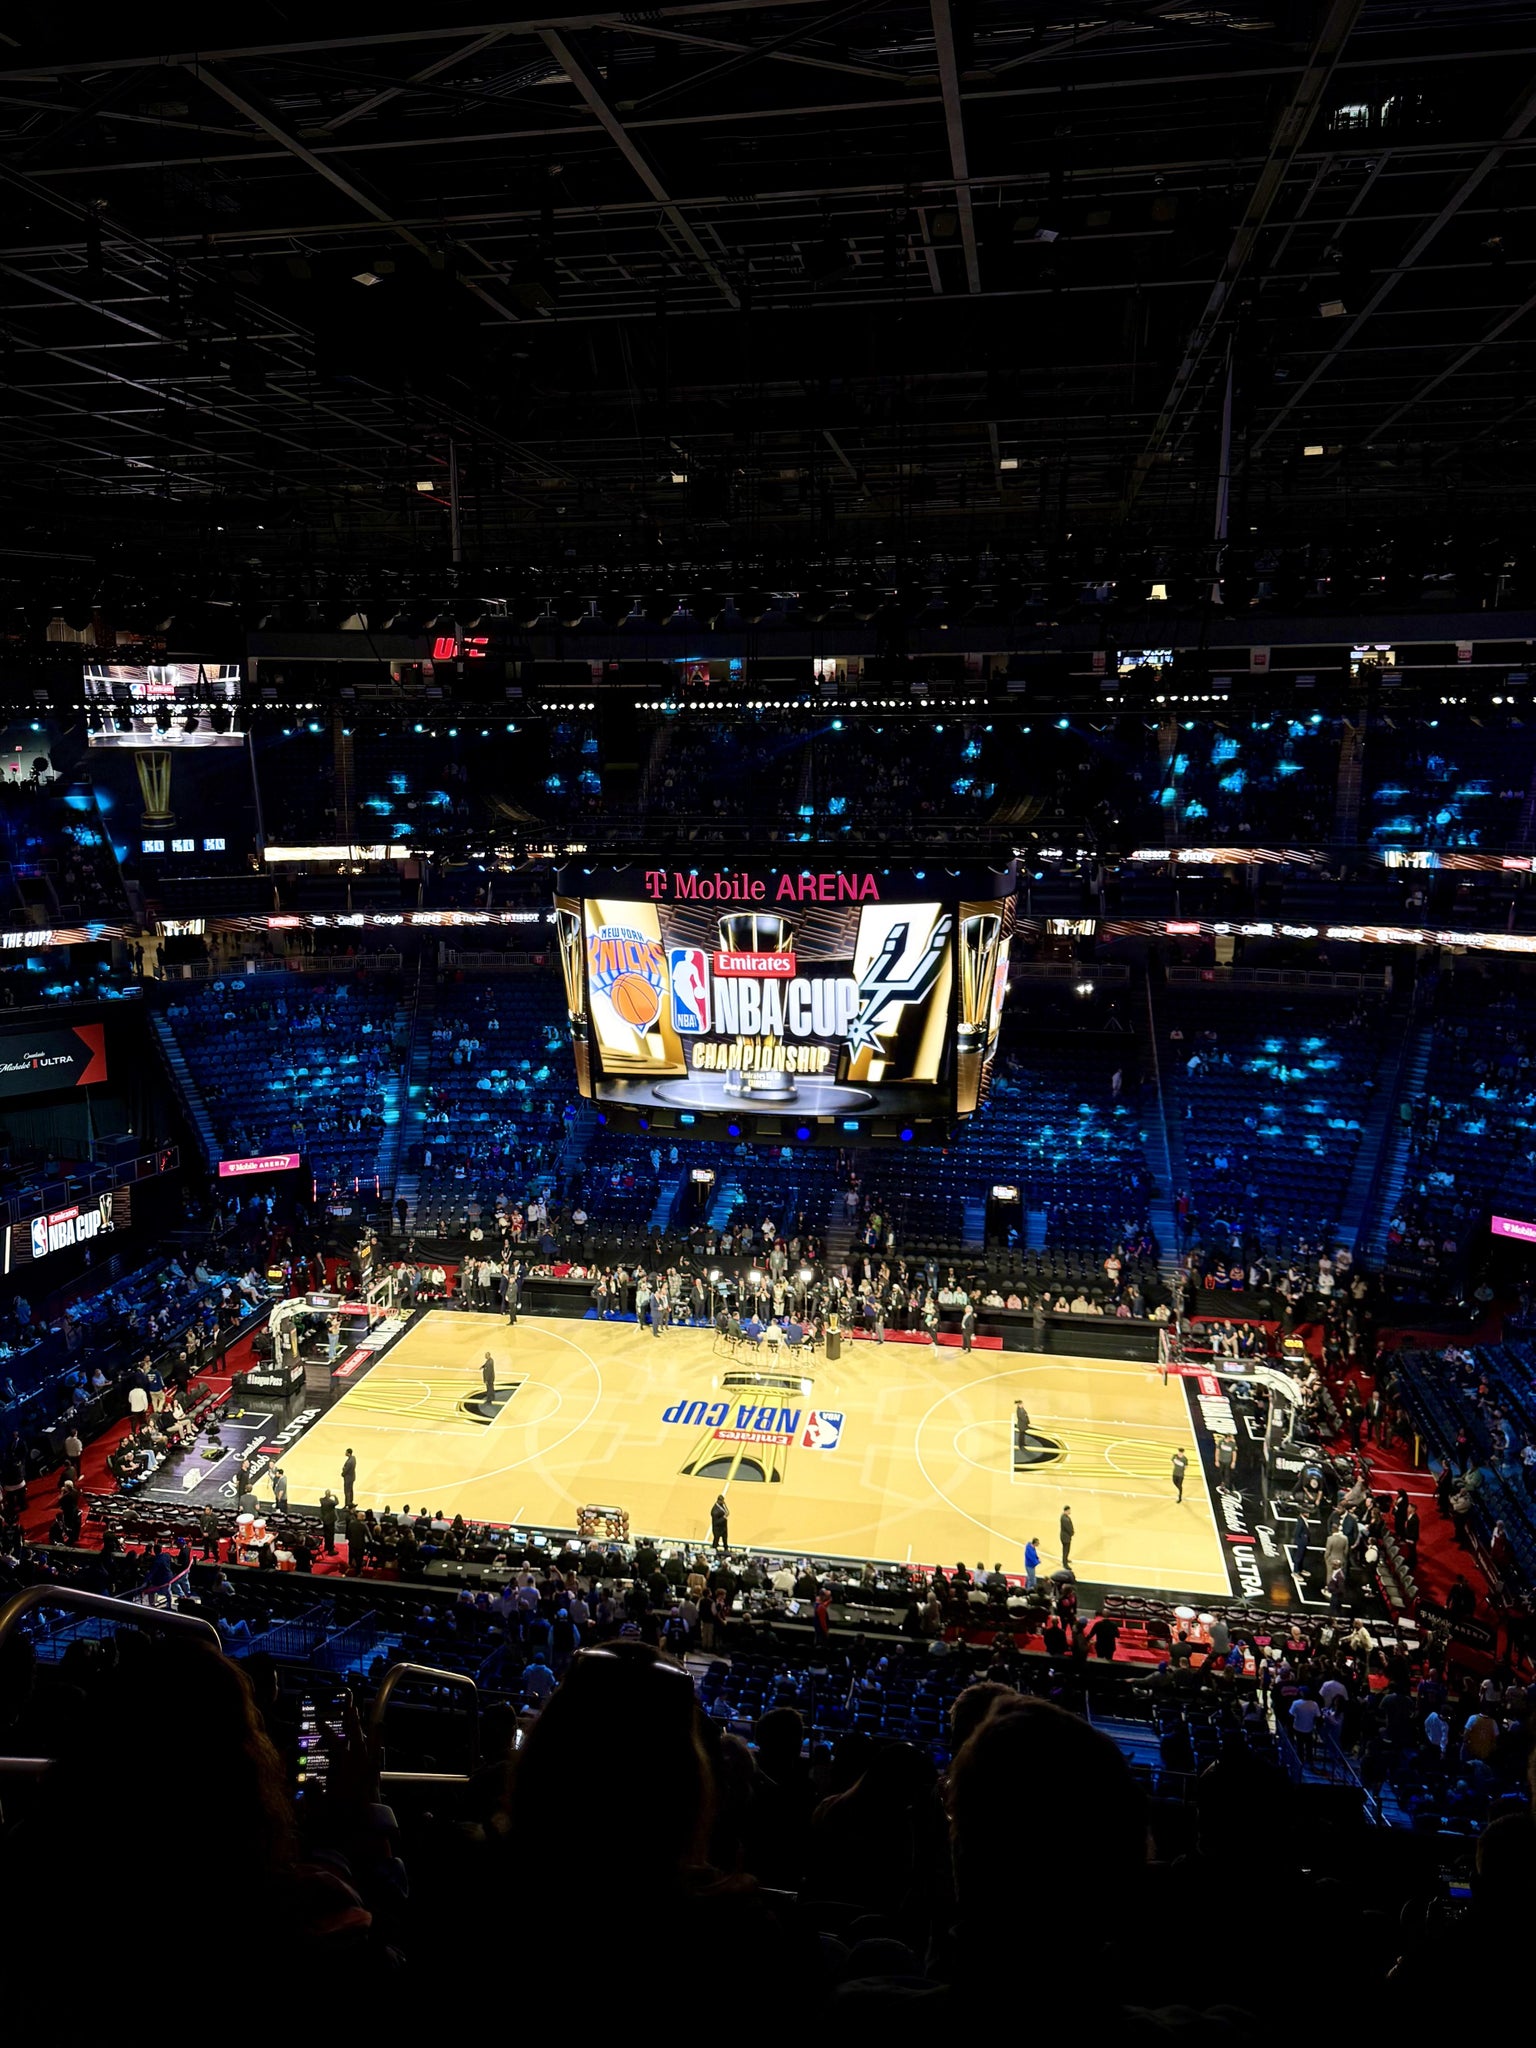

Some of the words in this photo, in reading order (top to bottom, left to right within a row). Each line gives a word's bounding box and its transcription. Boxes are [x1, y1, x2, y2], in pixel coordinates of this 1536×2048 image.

[673, 872, 766, 900] Mobile
[775, 873, 880, 900] ARENA
[2, 932, 25, 949] THE
[601, 927, 620, 939] NEW
[621, 927, 645, 943] YORK
[588, 938, 664, 976] KNICKS
[719, 954, 791, 971] Emirates
[714, 977, 784, 1036] NBA
[788, 977, 860, 1037] CUP
[677, 1014, 696, 1028] NBA
[40, 1055, 74, 1067] ULTRA
[692, 1042, 831, 1073] CHAMPIONSHIP
[259, 1160, 285, 1169] ARENA
[48, 1218, 77, 1252] NBA
[76, 1209, 102, 1242] CUP
[270, 1375, 283, 1387] Pass
[271, 1408, 322, 1445] ULTRA
[662, 1400, 730, 1427] CUP
[735, 1404, 802, 1434] NBA
[718, 1430, 788, 1445] Emirates
[1232, 1545, 1265, 1598] ULTRA
